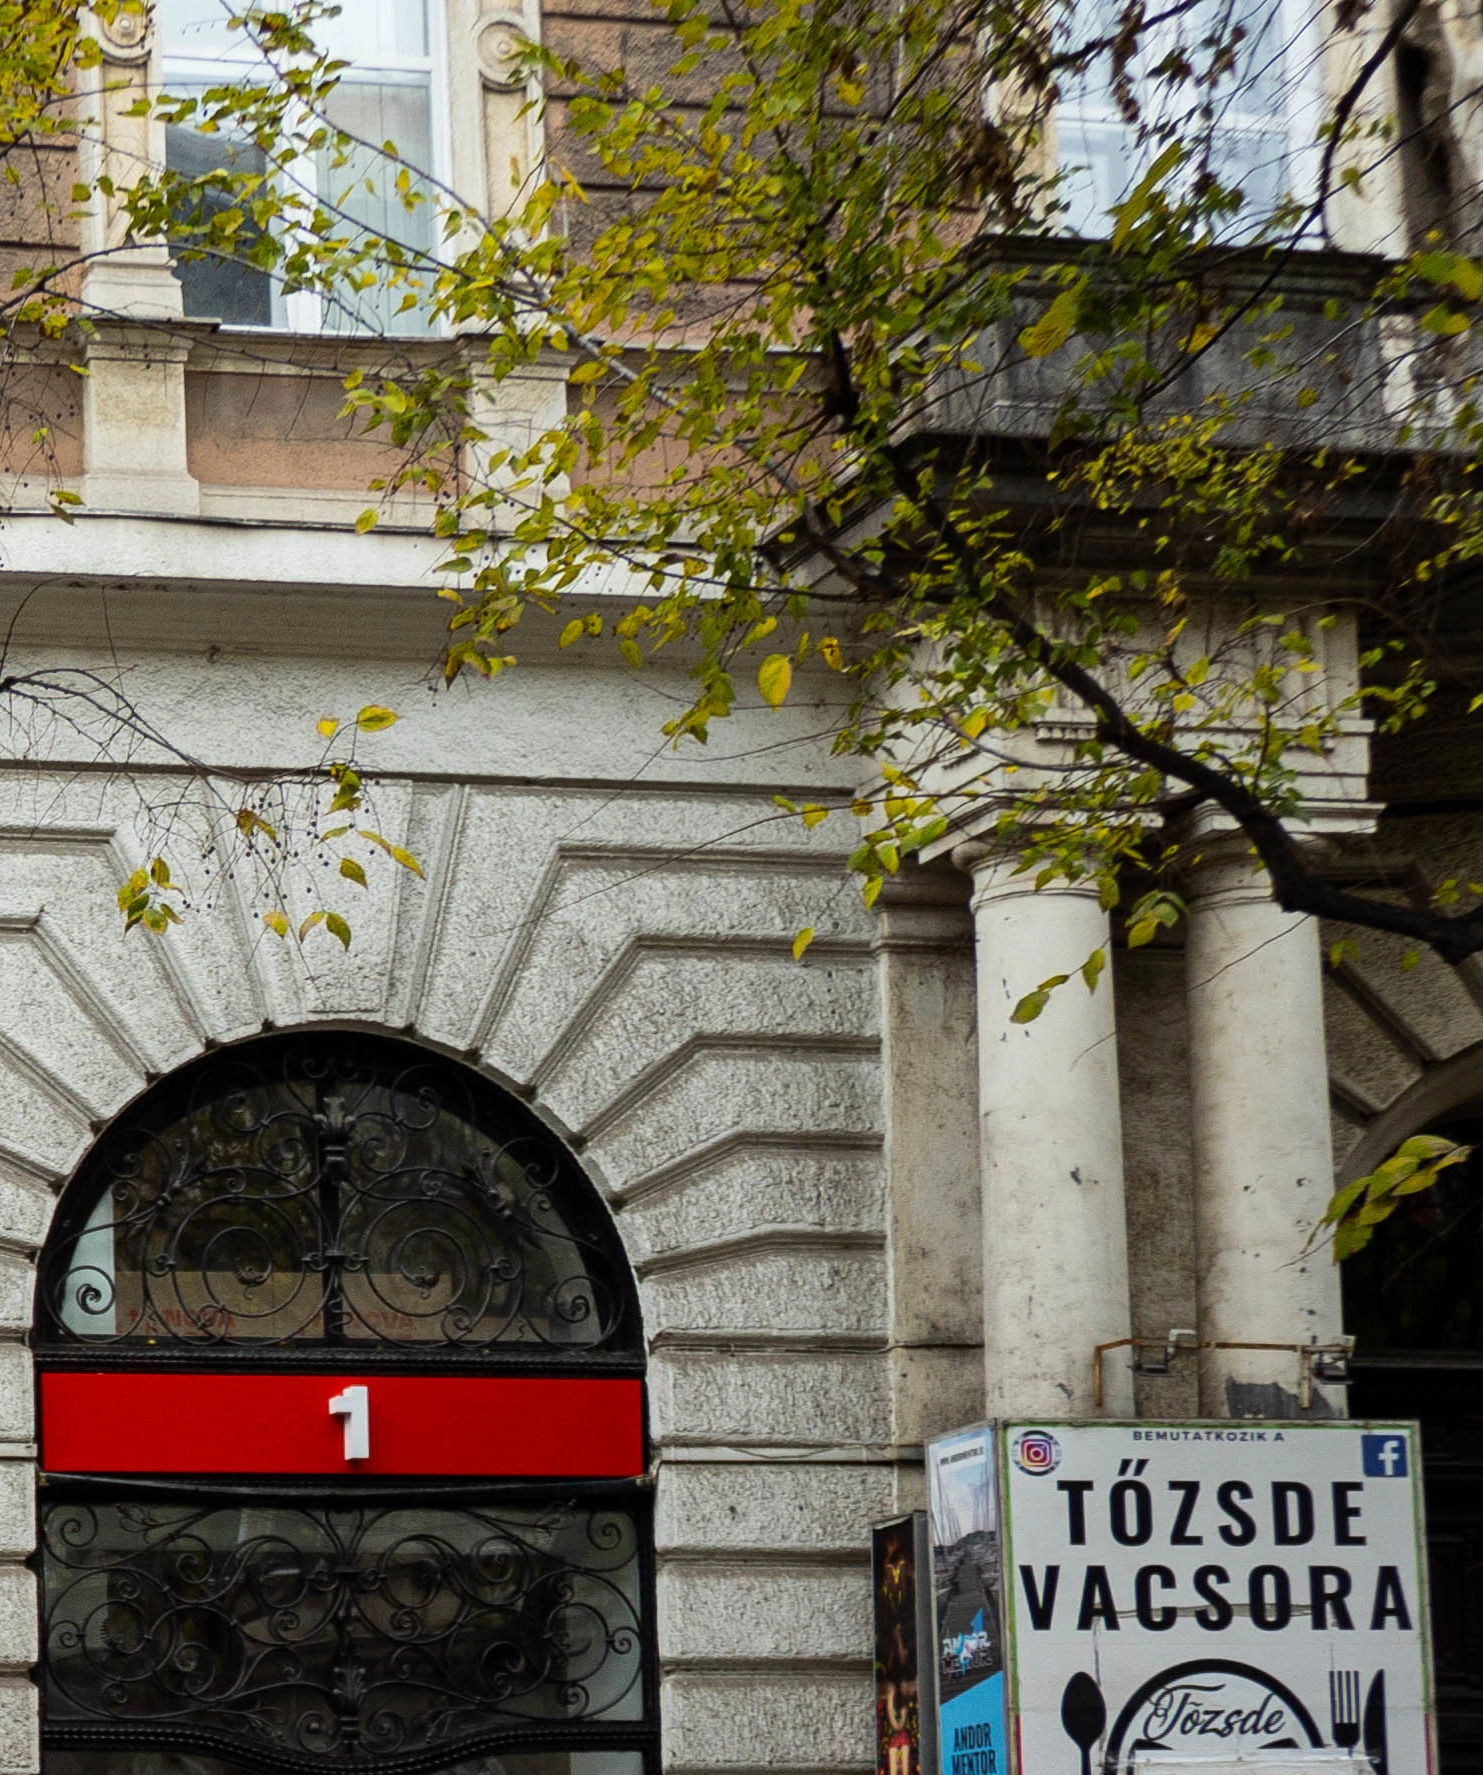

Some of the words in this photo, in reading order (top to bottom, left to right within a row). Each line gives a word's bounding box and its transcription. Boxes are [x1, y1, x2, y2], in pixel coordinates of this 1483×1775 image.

[328, 1386, 370, 1462] 1
[1133, 1431, 1267, 1442] BEMUTATKOZIK
[1273, 1431, 1285, 1442] A
[1057, 1458, 1368, 1547] TŐZSDE
[1019, 1564, 1414, 1632] VACSORA
[953, 1722, 993, 1752] ANDOR
